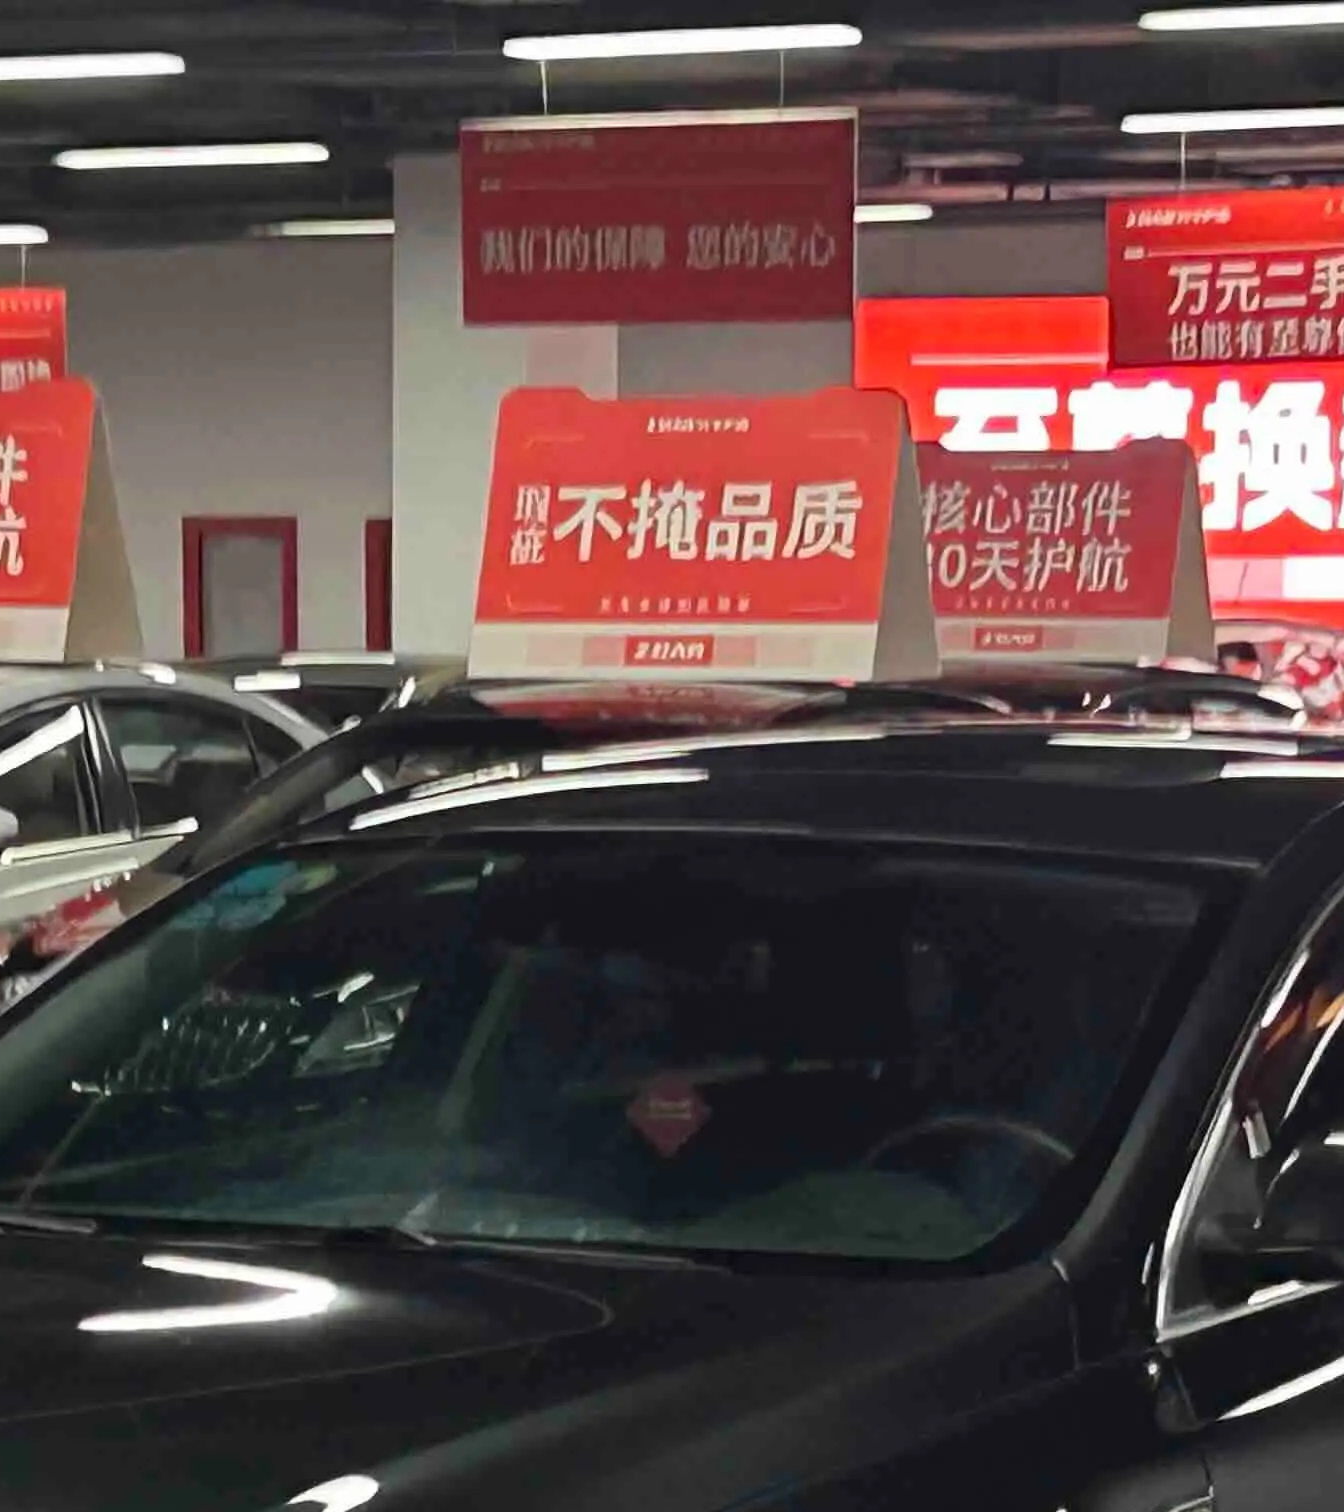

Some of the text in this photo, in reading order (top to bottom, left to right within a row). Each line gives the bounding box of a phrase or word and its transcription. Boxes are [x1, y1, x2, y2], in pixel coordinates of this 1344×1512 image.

[553, 478, 864, 562] 不掩品质
[921, 480, 1132, 536] 核心部件
